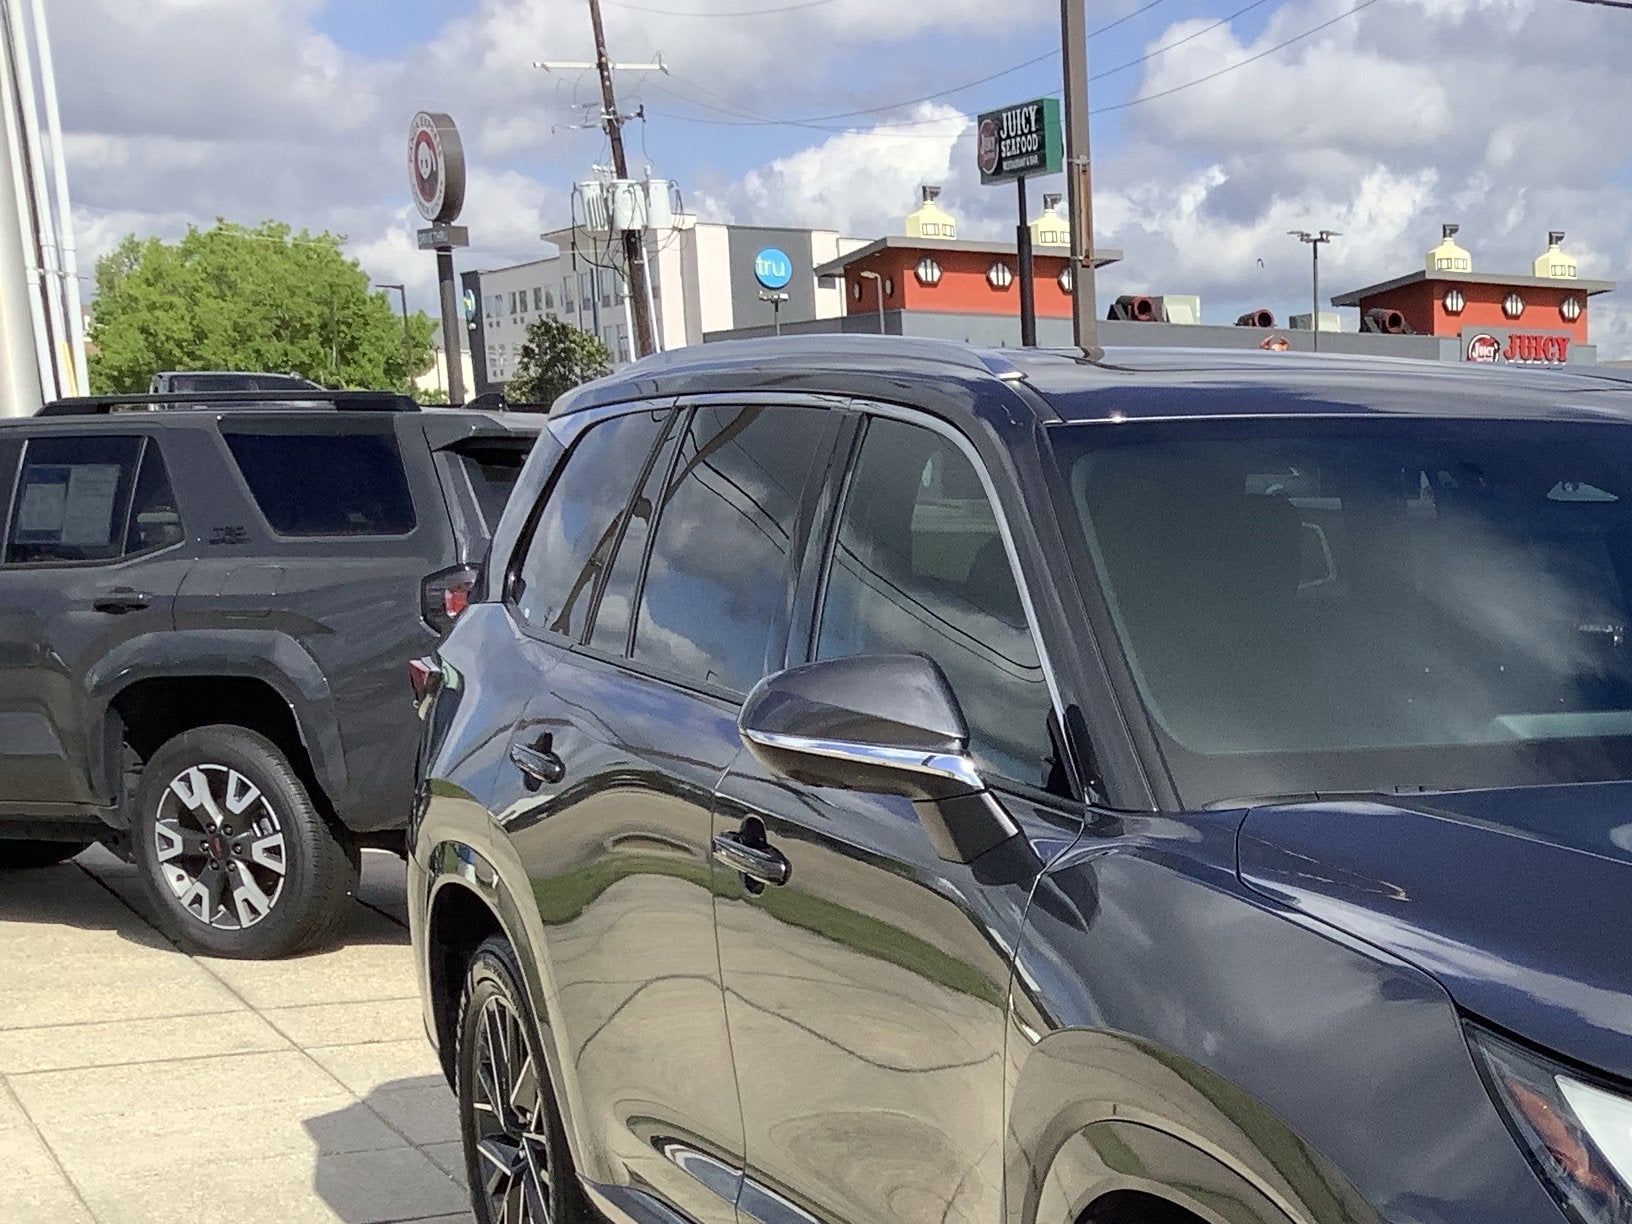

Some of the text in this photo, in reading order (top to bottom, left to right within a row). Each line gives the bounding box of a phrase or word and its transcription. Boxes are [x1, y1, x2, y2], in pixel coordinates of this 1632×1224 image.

[1000, 105, 1038, 139] JUICY
[1000, 133, 1038, 158] SEAFOOD
[755, 256, 785, 277] tru
[1503, 334, 1570, 362] JUICY
